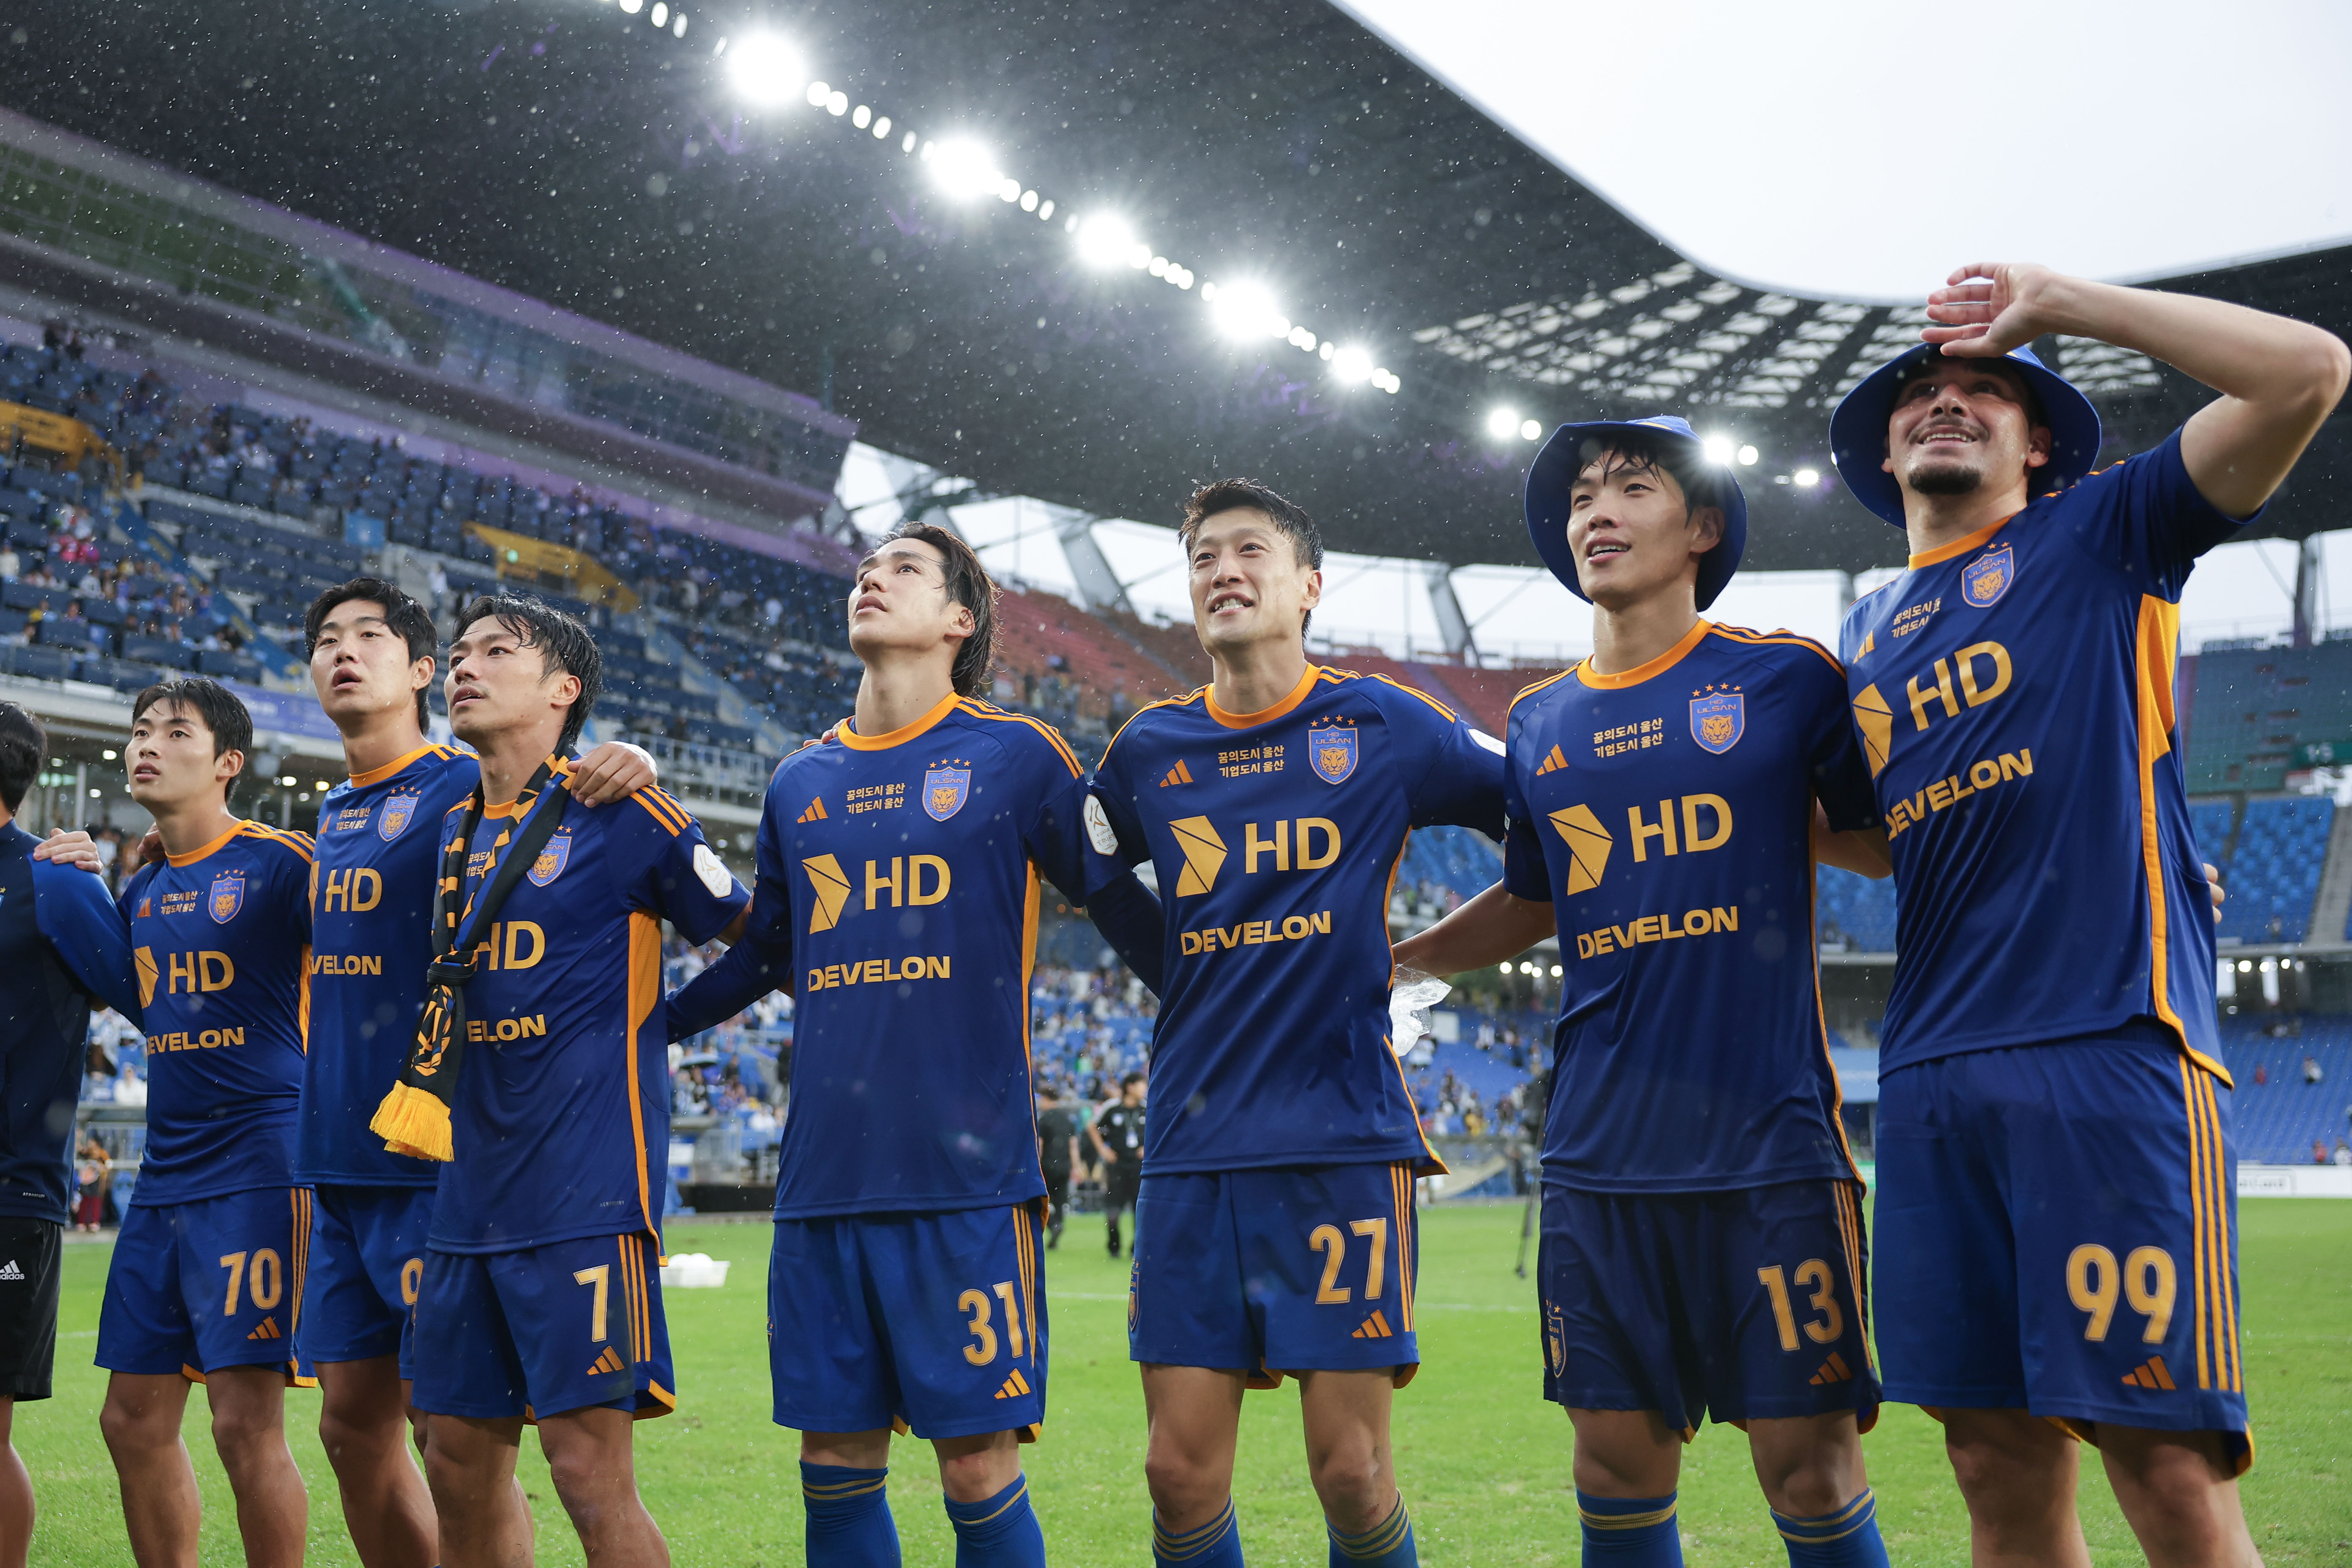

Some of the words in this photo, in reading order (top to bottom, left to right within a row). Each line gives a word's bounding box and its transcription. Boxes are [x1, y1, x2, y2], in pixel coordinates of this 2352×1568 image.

[1968, 558, 2006, 579] ULSAN
[1907, 641, 2013, 731] HD
[1593, 723, 1638, 744] 꿈의도시
[1640, 717, 1663, 733] 울산
[1697, 704, 1737, 714] ULSAN
[1218, 748, 1260, 764] 꿈의도시
[1262, 745, 1284, 759] 울산
[1593, 738, 1638, 758] 기업도시
[1640, 733, 1664, 749] 울산
[1219, 762, 1261, 778] 기업도시
[1263, 760, 1285, 773] 울산
[846, 785, 884, 801] 꿈의도시
[885, 783, 906, 795] 울산
[846, 799, 882, 814] 기업도시
[884, 797, 904, 809] 울산
[354, 819, 367, 829] 울산
[1245, 817, 1342, 874] HD
[1628, 793, 1733, 863] HD
[325, 868, 383, 912] HD
[865, 854, 952, 911] HD
[1180, 911, 1332, 956] DEVELON
[1577, 906, 1739, 960] DEVELON
[169, 950, 235, 994] HD
[808, 956, 951, 992] DEVELON
[148, 1027, 245, 1054] EVELON
[0, 1272, 25, 1280] didas
[219, 1248, 282, 1316] 70
[1309, 1218, 1387, 1305] 27
[573, 1264, 609, 1343] 7
[1757, 1259, 1844, 1352] 13
[2065, 1244, 2177, 1345] 99
[958, 1281, 1024, 1366] 31
